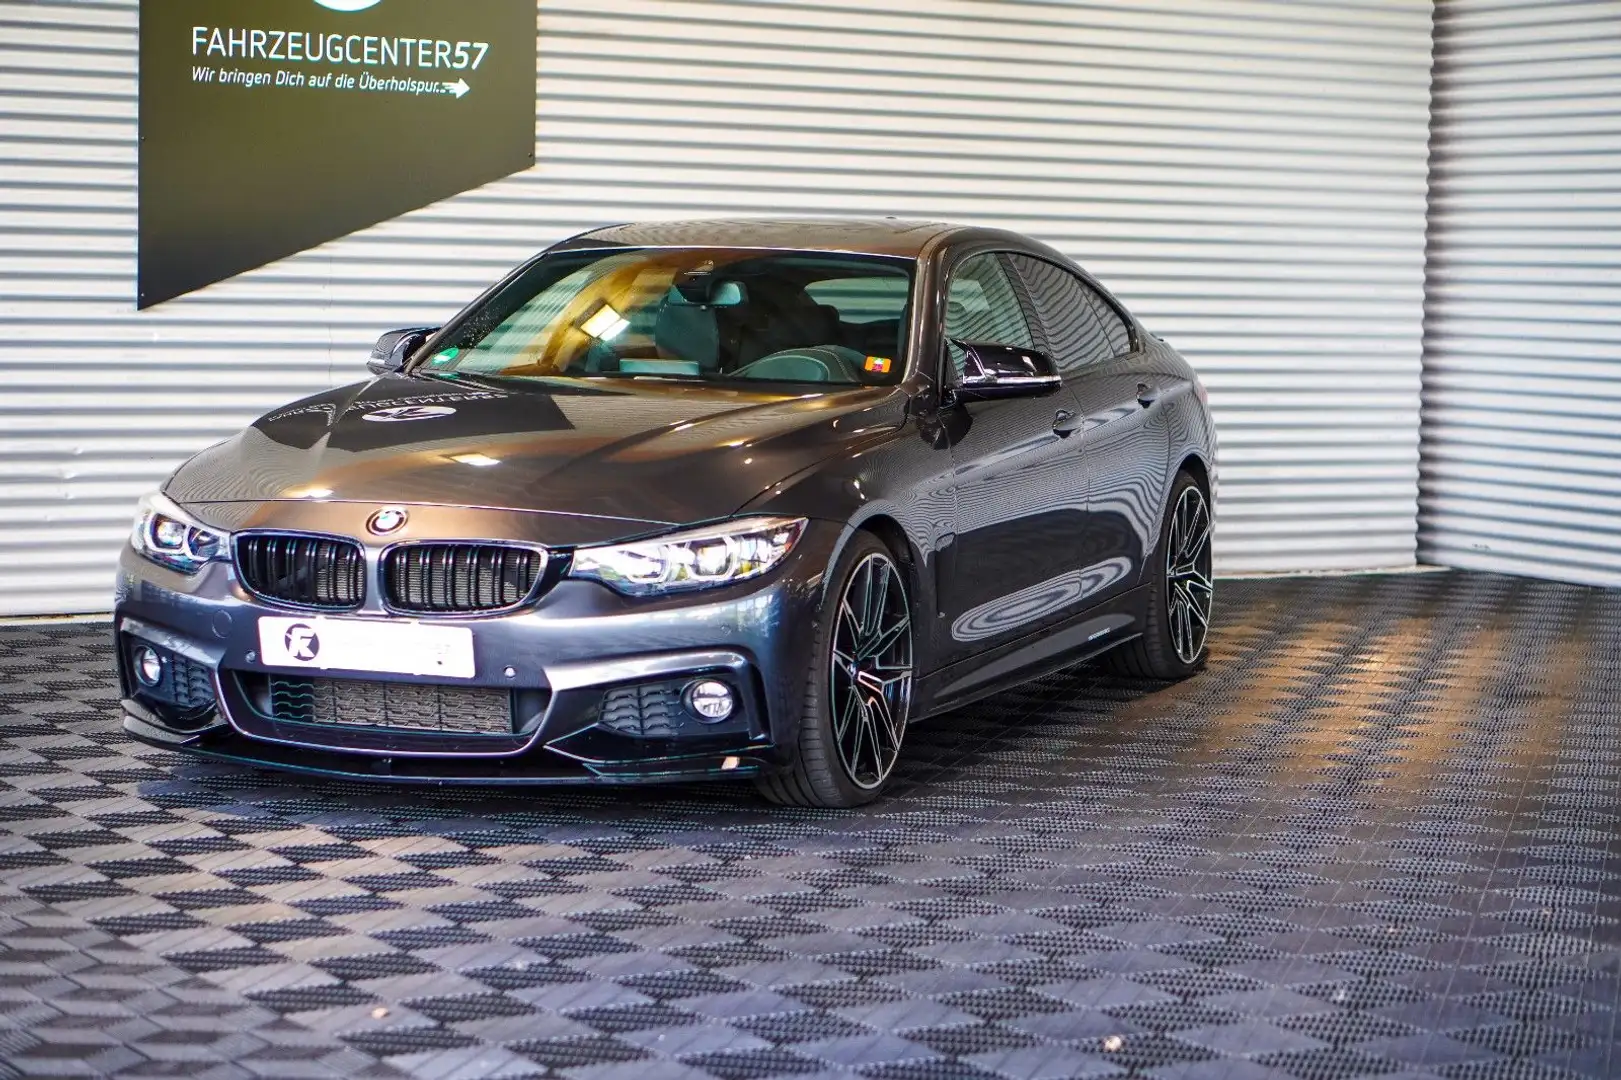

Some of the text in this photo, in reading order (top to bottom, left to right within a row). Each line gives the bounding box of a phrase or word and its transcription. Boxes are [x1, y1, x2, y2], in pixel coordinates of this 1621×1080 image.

[192, 26, 489, 70] FAHRZEUGCENTER57
[192, 65, 215, 82] Wir
[219, 67, 271, 87] bringen
[275, 70, 305, 87] Dich
[308, 72, 332, 88] auf
[334, 73, 355, 89] die
